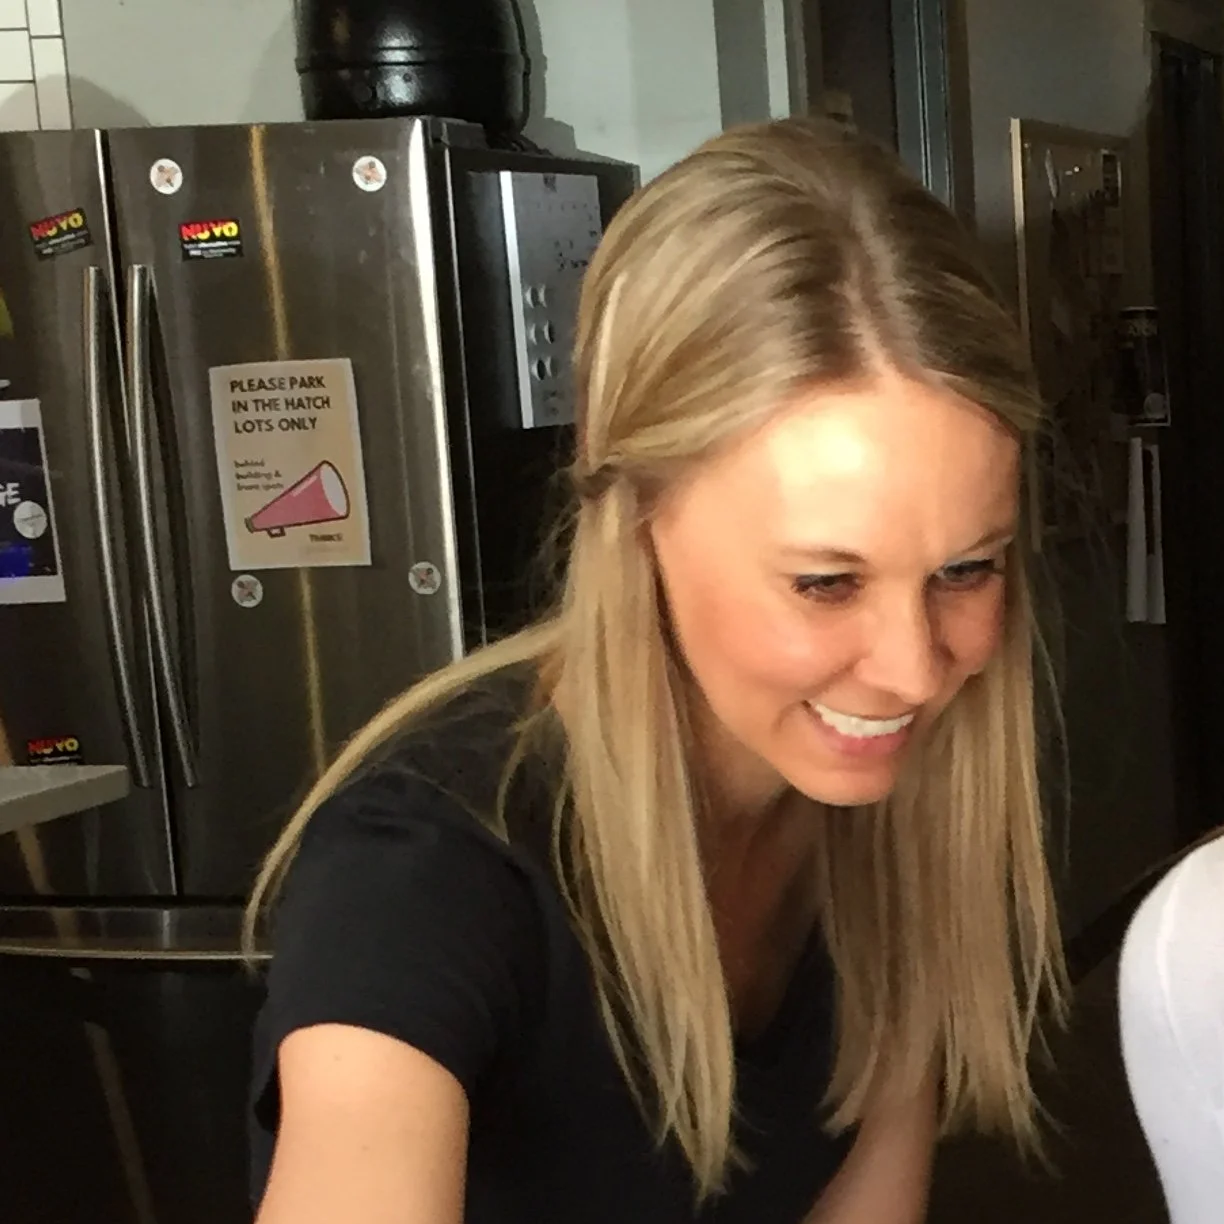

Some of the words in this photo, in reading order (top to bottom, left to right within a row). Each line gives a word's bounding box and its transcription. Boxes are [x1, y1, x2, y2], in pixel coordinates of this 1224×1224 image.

[31, 212, 83, 240] NUVO
[181, 221, 238, 240] NUVO
[230, 378, 286, 393] PLEASE
[290, 376, 326, 389] PARK
[232, 400, 249, 414] IN
[253, 398, 281, 412] THE
[285, 396, 331, 411] HATCH
[234, 418, 275, 434] LOTS
[278, 417, 318, 432] ONLY
[28, 738, 79, 756] NUVO
